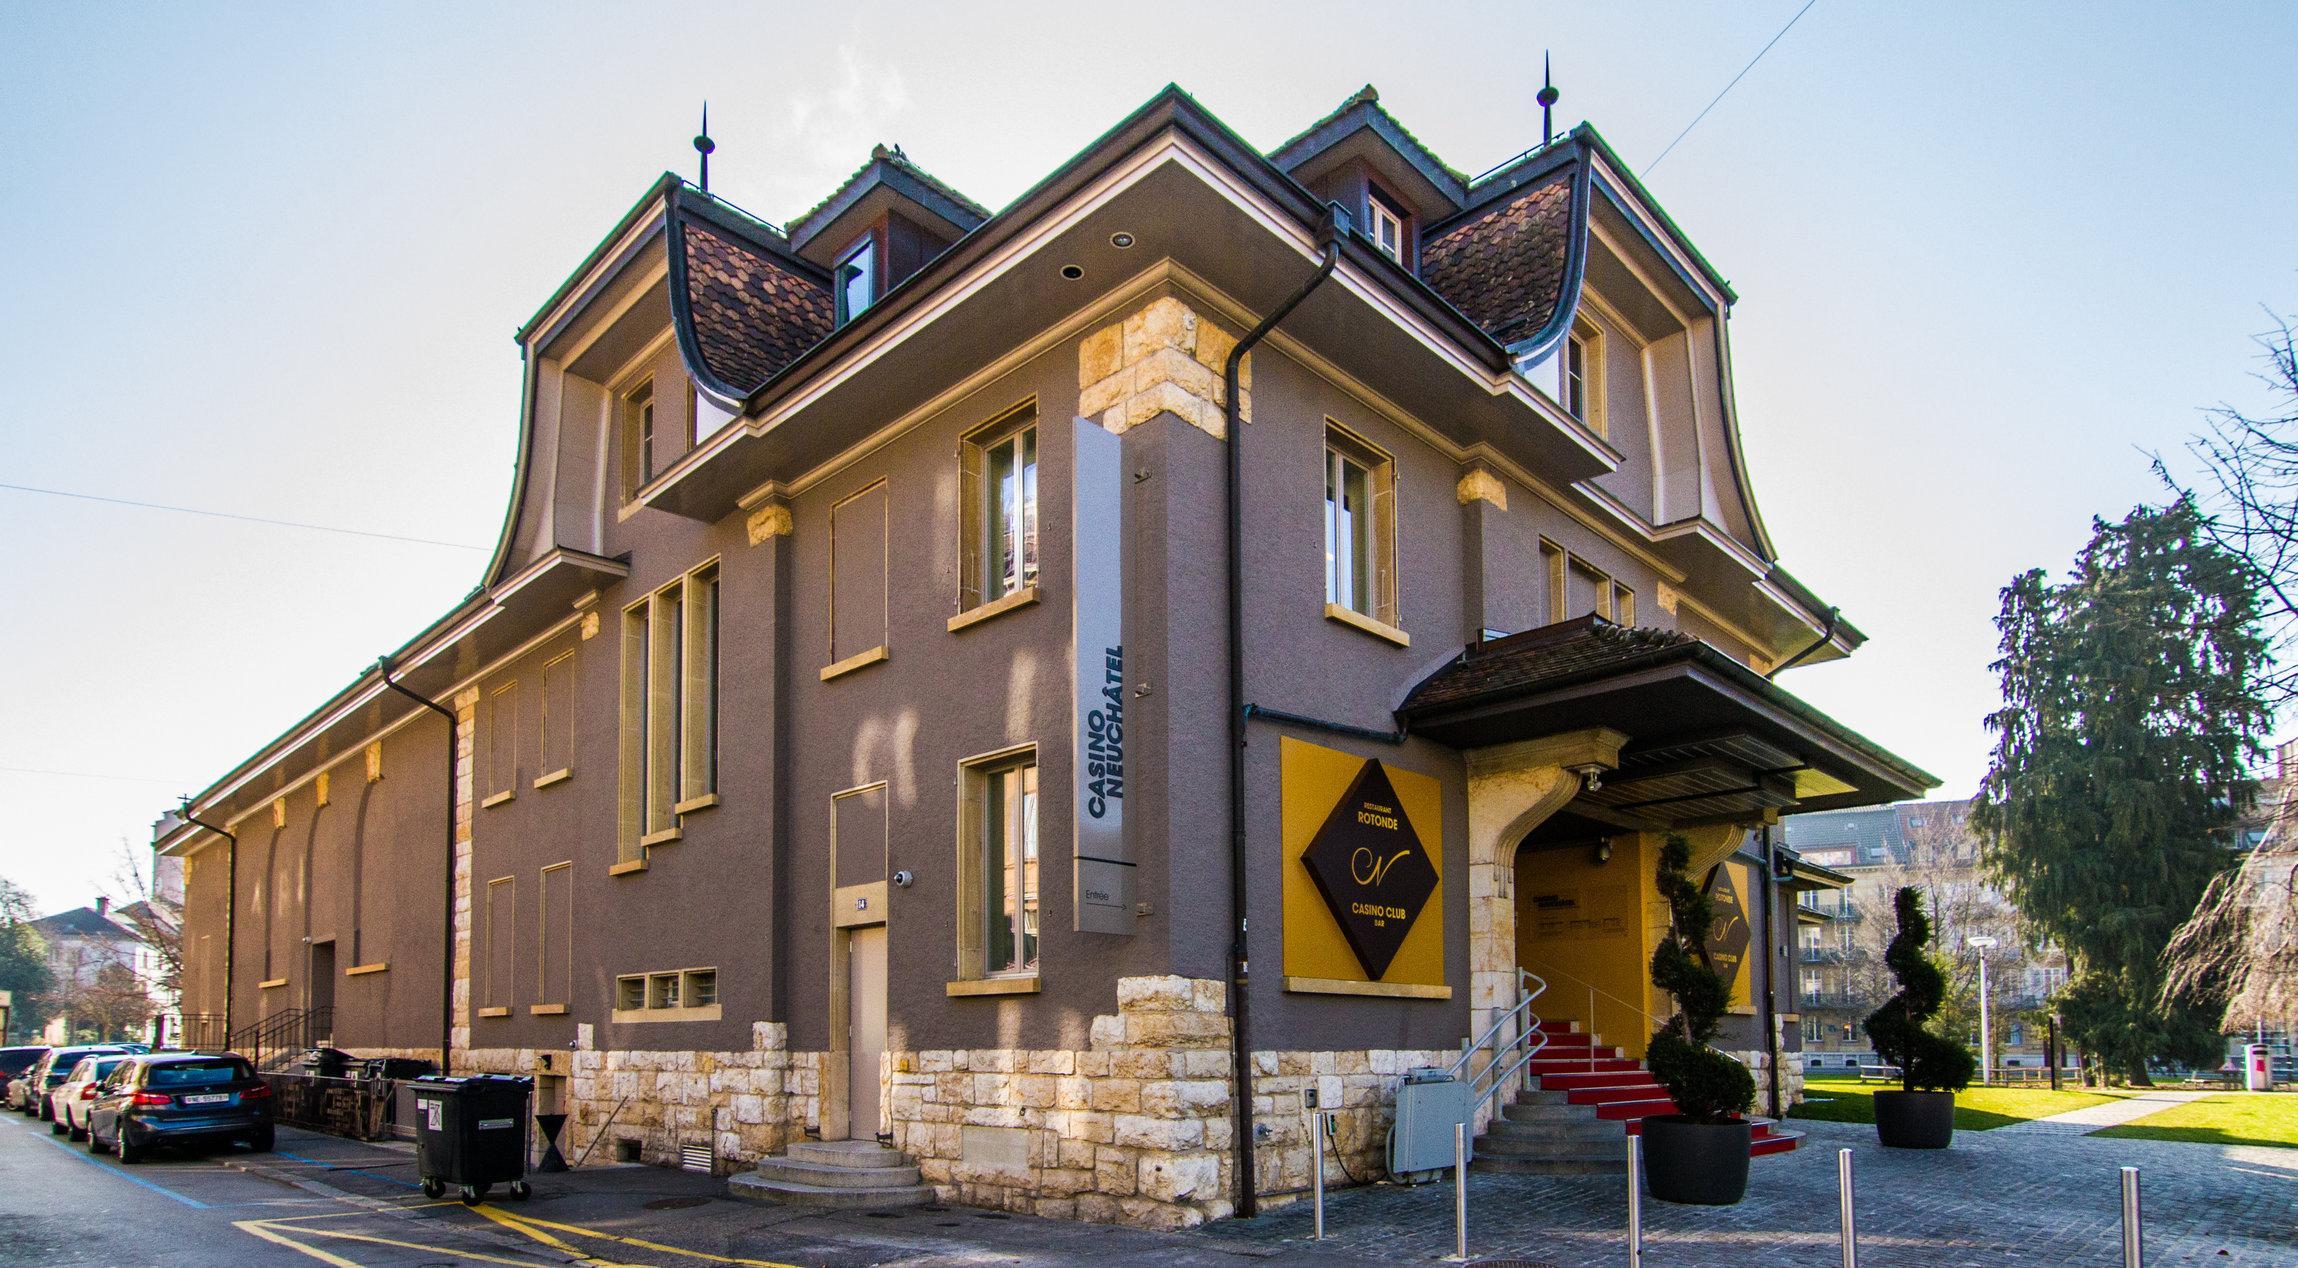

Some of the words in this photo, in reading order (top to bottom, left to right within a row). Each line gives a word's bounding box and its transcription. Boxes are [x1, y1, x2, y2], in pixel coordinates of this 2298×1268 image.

[1102, 645, 1124, 799] NEUCHÂTEL
[1088, 709, 1106, 819] CASINO
[1358, 811, 1398, 830] ROTONDE
[1352, 902, 1384, 917] CASINO
[1385, 906, 1406, 920] CLUB
